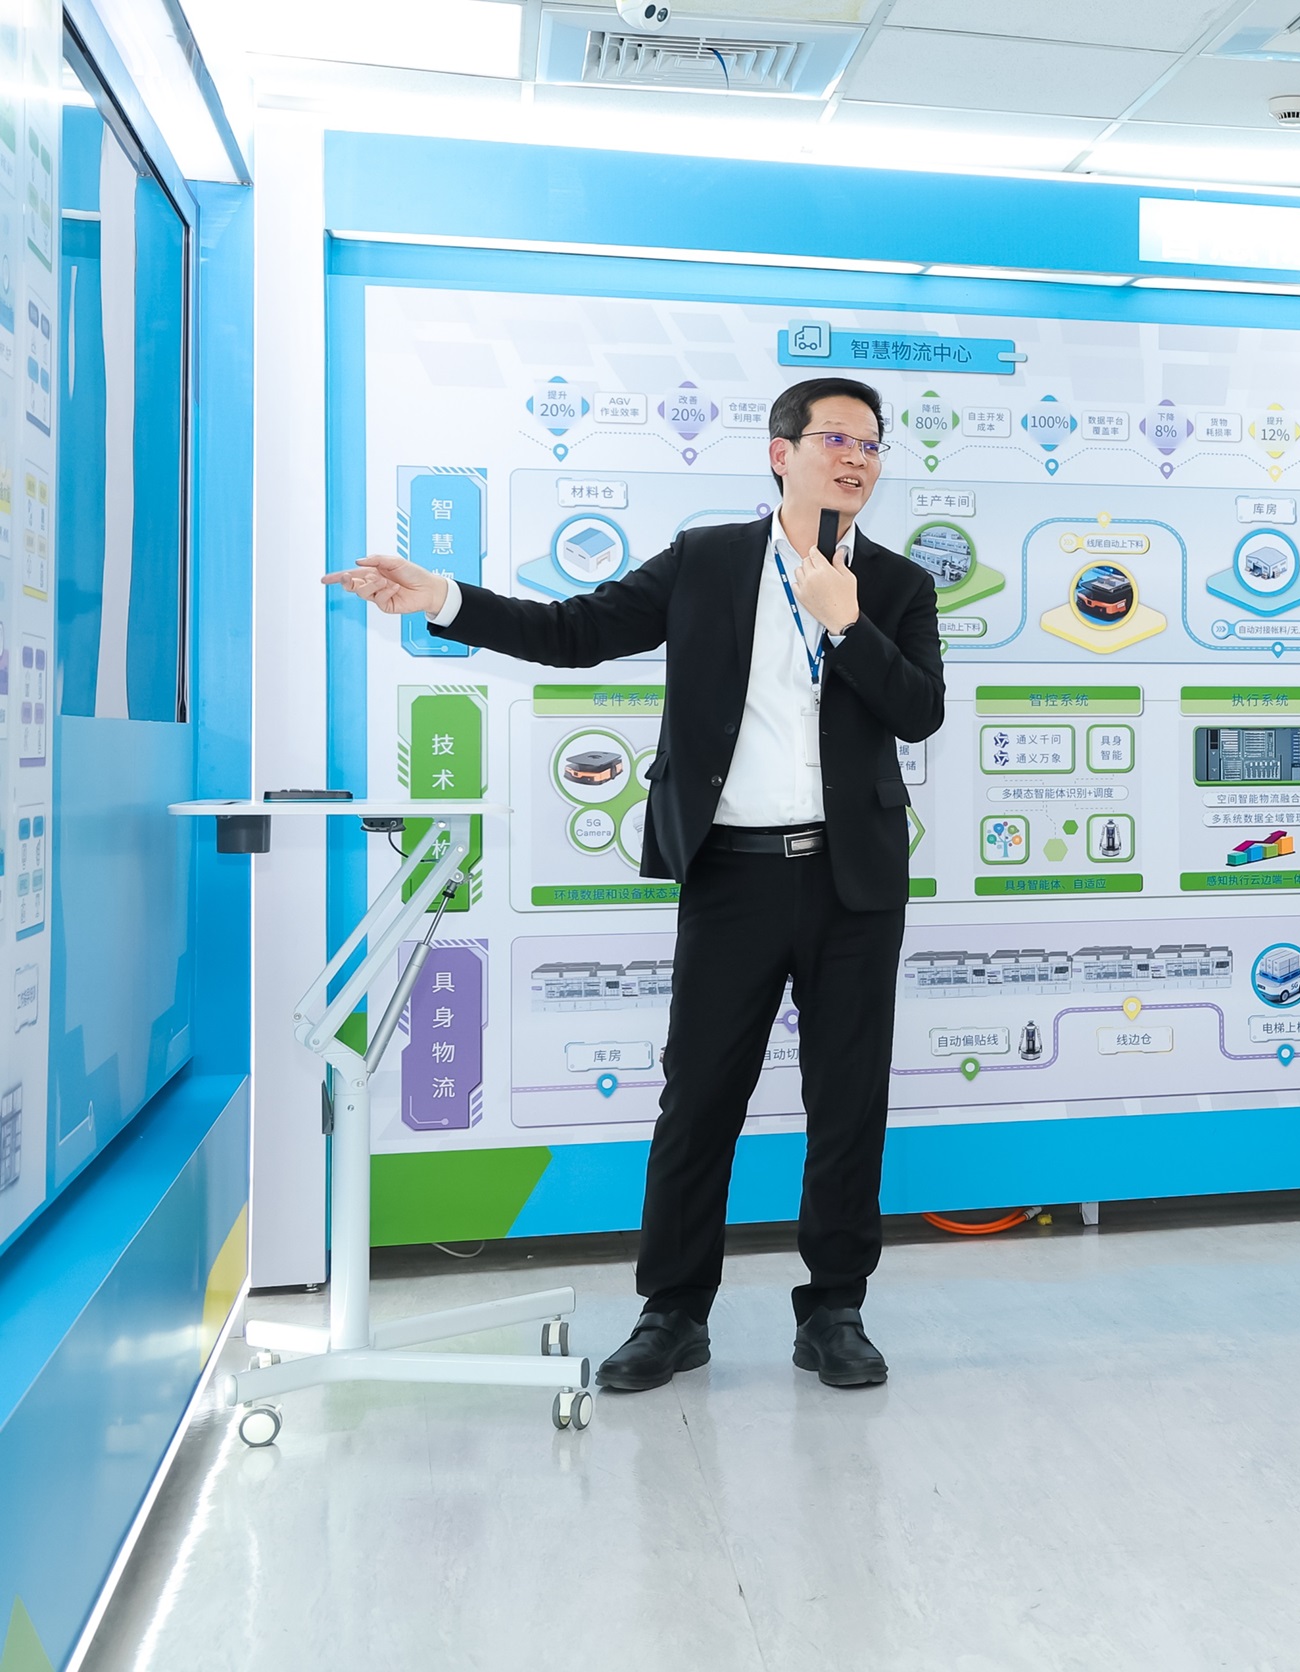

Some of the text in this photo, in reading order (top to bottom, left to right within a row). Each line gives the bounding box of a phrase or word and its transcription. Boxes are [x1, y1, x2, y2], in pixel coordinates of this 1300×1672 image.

[851, 340, 972, 364] 智慧物流中心
[547, 390, 567, 400] 提升
[678, 395, 698, 405] 改善
[609, 397, 631, 406] AGV
[540, 403, 575, 418] 20%
[600, 407, 640, 418] 作业效率
[728, 402, 767, 413] 仓储空间
[921, 403, 941, 414] 降低
[671, 408, 706, 423] 20%
[733, 413, 762, 423] 利用率
[968, 412, 1005, 422] 自主开发
[1088, 416, 1124, 426] 数据平台
[1157, 412, 1175, 422] 下降
[1267, 416, 1284, 426] 提升
[915, 416, 948, 431] 80%
[977, 422, 995, 432] 成本
[1031, 415, 1069, 430] 100%
[1210, 417, 1228, 427] 货物
[1092, 426, 1119, 436] 覆盖率
[1155, 424, 1177, 438] 8%
[1206, 428, 1232, 438] 耗损率
[1260, 428, 1290, 442] 12%
[571, 485, 615, 500] 材料仓
[916, 494, 971, 508] 生产车间
[1253, 503, 1278, 515] 库房
[1086, 539, 1144, 550] 线尾自动上下料
[939, 623, 981, 632] 自动上下料
[592, 692, 659, 708] 硬件系统
[1029, 693, 1089, 707] 智控系统
[1231, 694, 1289, 707] 执行系统
[1016, 734, 1062, 745] 通义千问
[1101, 735, 1122, 746] 具身
[1016, 753, 1062, 764] 通义万象
[1100, 750, 1123, 761] 智能
[1002, 788, 1114, 799] 多模态智能体识别+调度
[1217, 793, 1300, 805] 空间智能物流融合
[586, 818, 601, 827] 5G
[576, 828, 612, 838] Camera
[1004, 879, 1107, 891] 具身智能体、自适应
[1290, 982, 1299, 990] 5G
[431, 972, 456, 1099] 具身物流
[937, 1034, 999, 1047] 自动偏贴线
[1116, 1033, 1152, 1046] 线边仓
[593, 1049, 622, 1063] 库房
